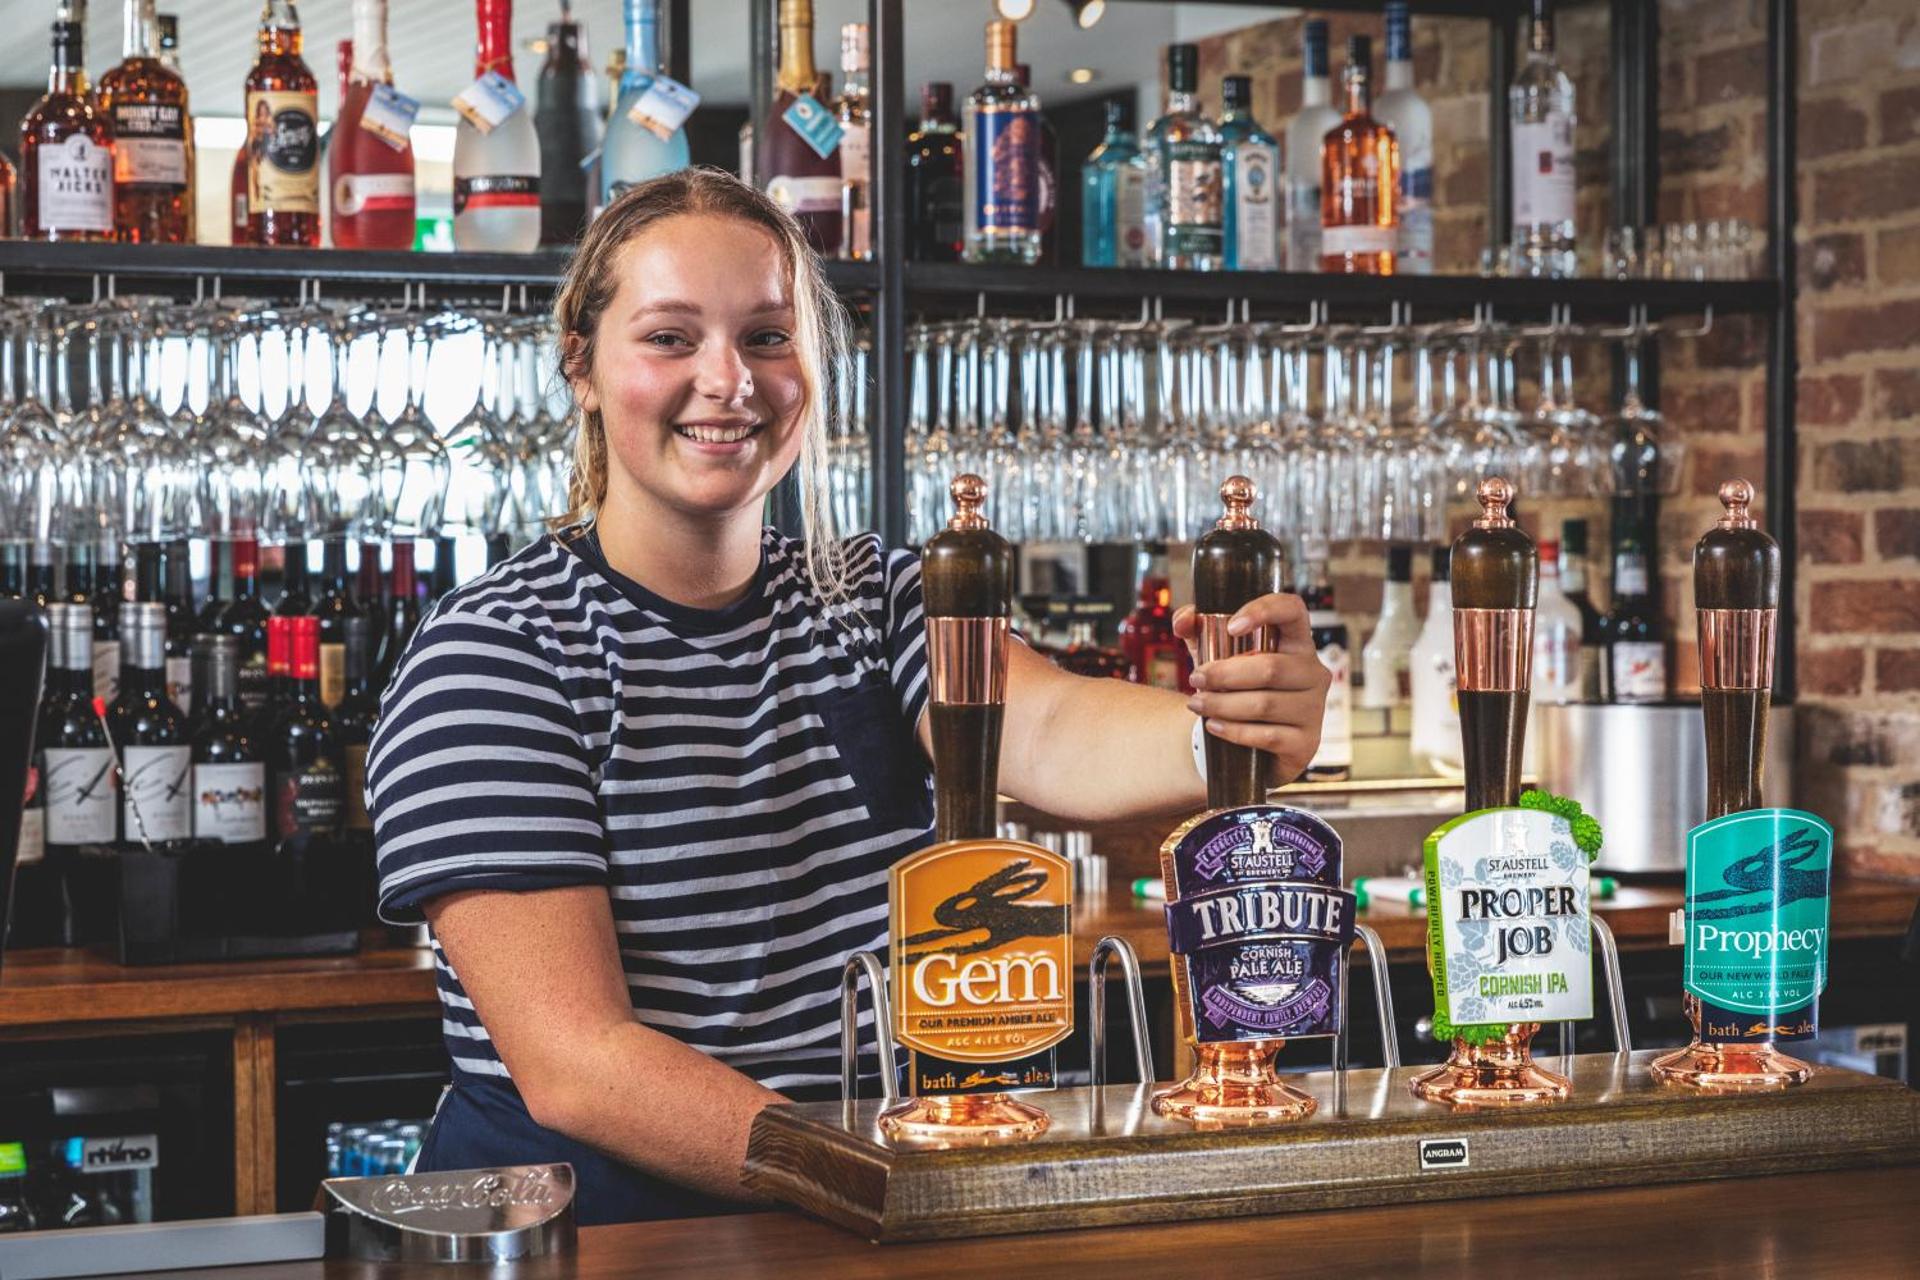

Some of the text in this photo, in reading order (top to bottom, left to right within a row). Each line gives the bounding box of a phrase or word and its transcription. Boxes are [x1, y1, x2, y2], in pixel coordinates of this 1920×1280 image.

[1243, 854, 1294, 868] AUSTELL
[1501, 857, 1548, 871] AUSTELL
[1461, 886, 1578, 919] PROPER
[1192, 890, 1344, 940] TRIBUTE
[1428, 870, 1445, 997] POWERFULLY HOPPED
[1697, 924, 1825, 960] Prophecy
[1240, 948, 1292, 962] CORNISH
[1497, 925, 1553, 965] JOB
[913, 952, 1064, 1007] Gem
[1230, 960, 1303, 979] PALE ALE
[1700, 970, 1723, 981] OUR
[1727, 970, 1752, 981] NEW
[1479, 972, 1568, 998] CORNISH IPA
[1732, 991, 1753, 999] ALC
[1783, 988, 1801, 998] VOL
[919, 1013, 1056, 1029] OUR PREMIUM AMBER ALE
[1708, 1019, 1816, 1037] bath ales
[922, 1066, 1051, 1090] bath ales
[88, 1139, 151, 1164] rhino
[1425, 1148, 1464, 1159] ANGRAM
